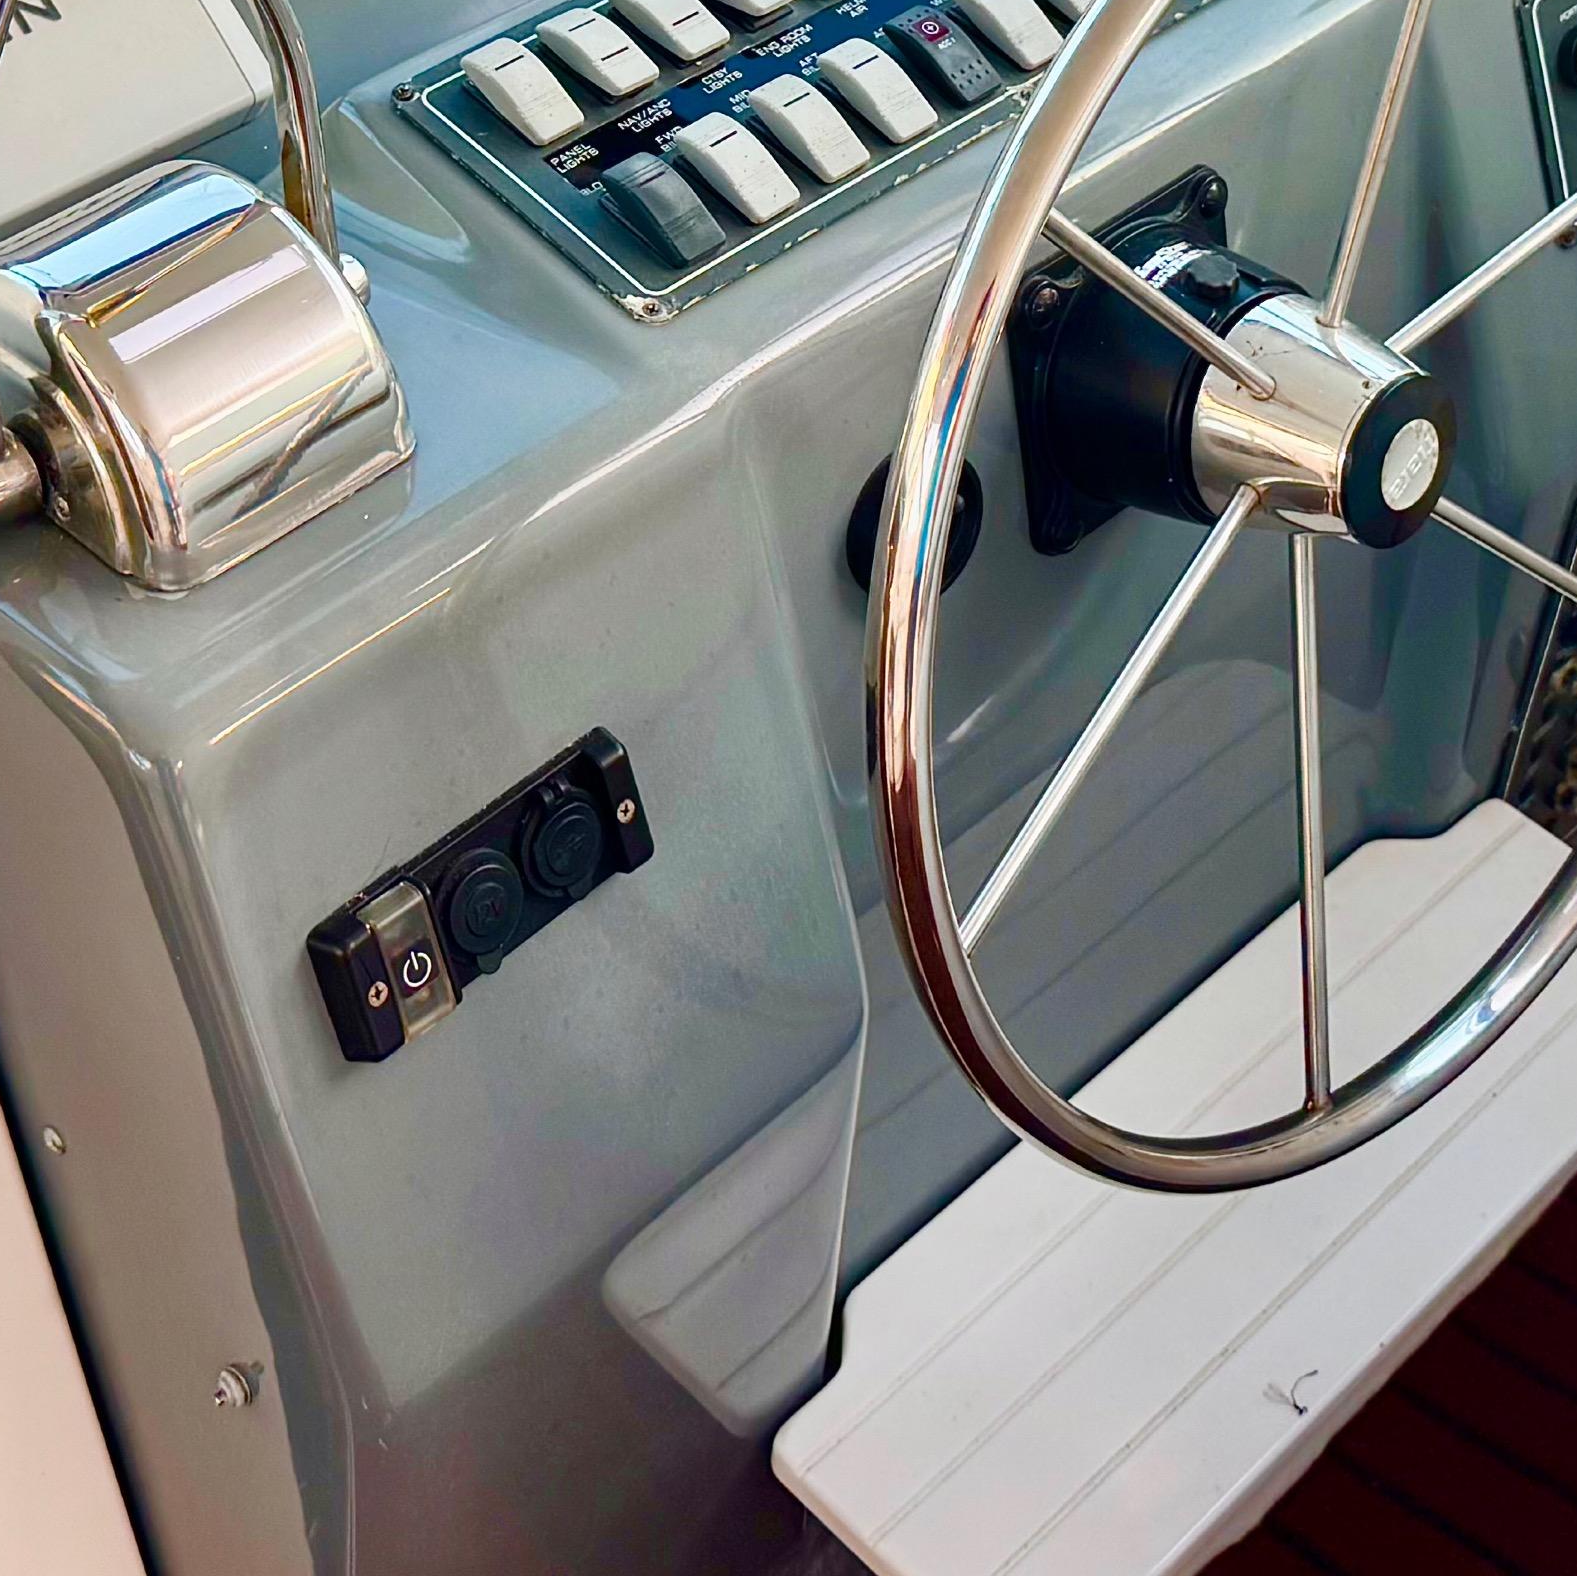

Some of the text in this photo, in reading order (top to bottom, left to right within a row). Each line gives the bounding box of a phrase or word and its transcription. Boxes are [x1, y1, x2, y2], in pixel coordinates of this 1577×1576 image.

[850, 5, 869, 18] AIR
[755, 24, 813, 57] ENG ROOM
[773, 34, 811, 58] LIGHTS
[799, 52, 819, 69] AFT
[701, 66, 729, 85] CTSY
[703, 70, 743, 94] LIGHTS
[617, 98, 672, 131] NAV/ANC
[630, 109, 673, 133] LIGHTS
[550, 142, 591, 166] PANEL
[556, 147, 599, 174] LIGHTS
